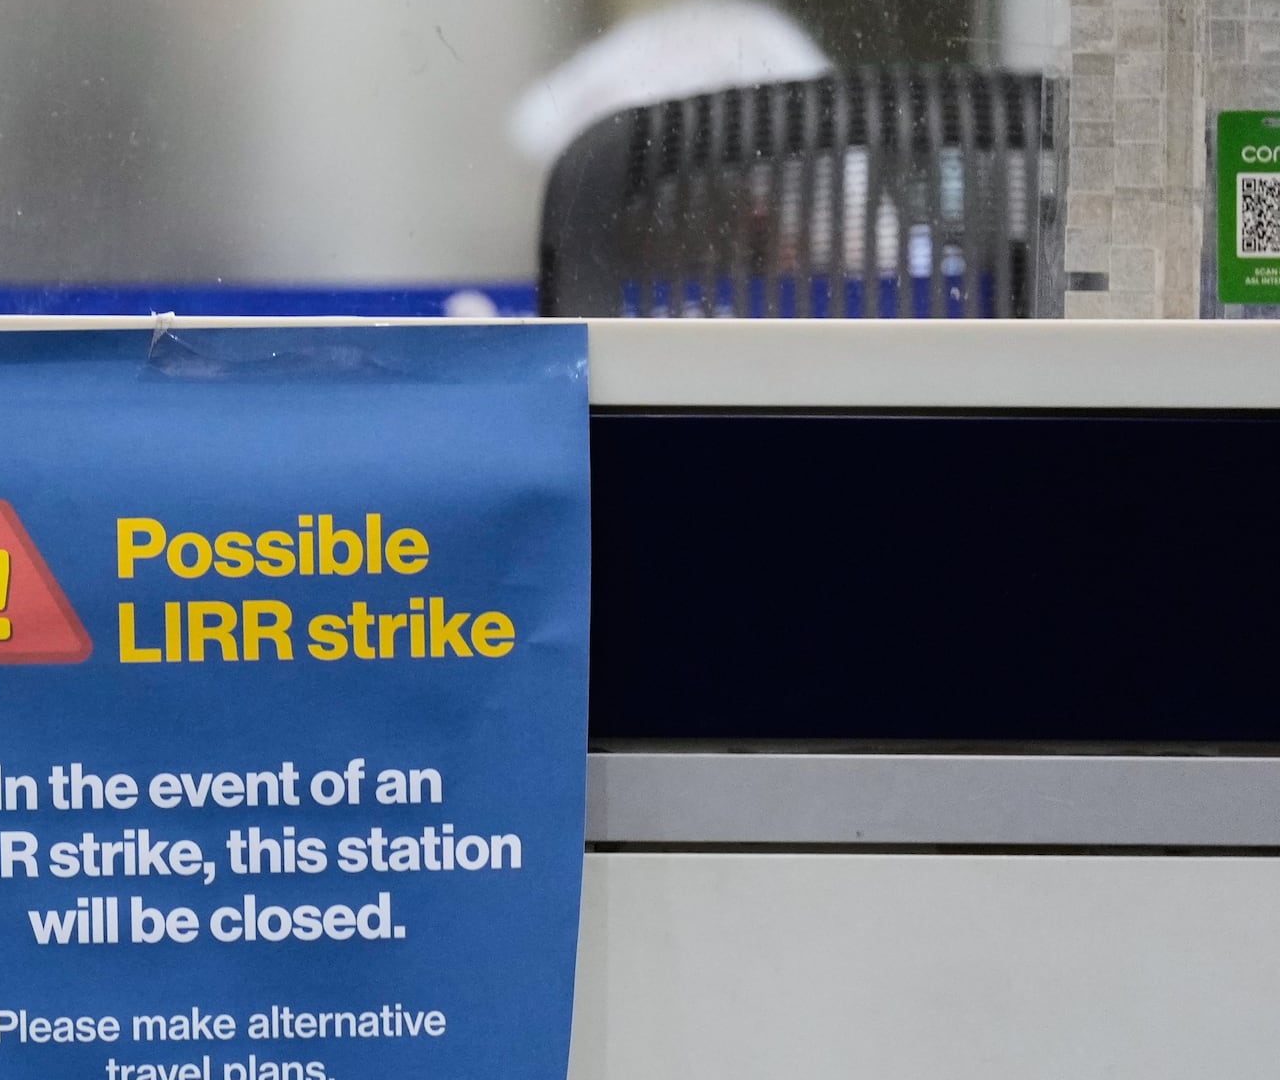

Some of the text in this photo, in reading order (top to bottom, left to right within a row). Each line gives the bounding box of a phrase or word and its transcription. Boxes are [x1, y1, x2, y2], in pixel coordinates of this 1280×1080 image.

[117, 513, 430, 579] Possible
[119, 597, 516, 663] LIRR strike
[48, 762, 139, 810] the
[148, 761, 300, 809] event
[310, 757, 366, 806] of
[375, 768, 443, 805] an
[49, 828, 216, 885] strike,
[226, 826, 328, 874] this
[337, 823, 522, 873] station
[27, 891, 406, 945] will be closed.
[132, 1006, 236, 1041] make
[247, 1003, 447, 1040] alternative
[105, 1055, 211, 1080] travel
